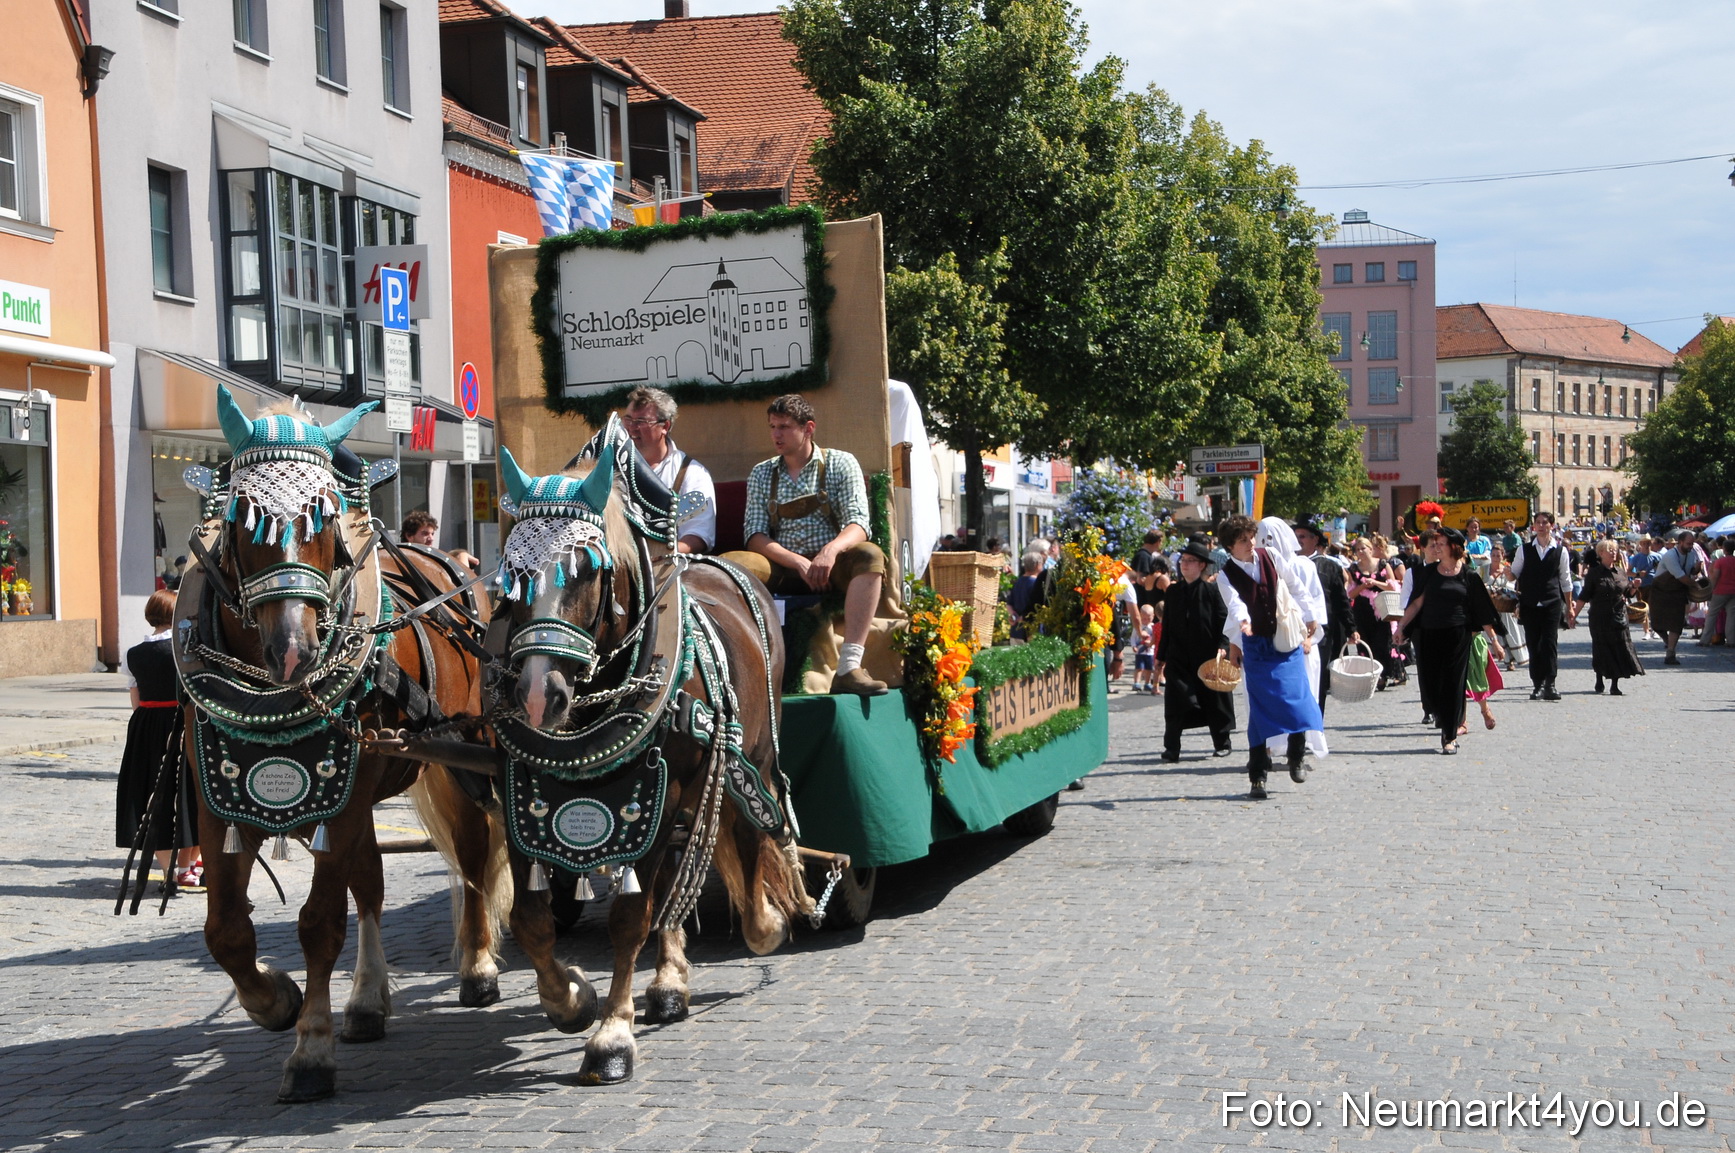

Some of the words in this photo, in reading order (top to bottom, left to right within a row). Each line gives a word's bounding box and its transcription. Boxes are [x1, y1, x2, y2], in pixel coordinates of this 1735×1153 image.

[362, 261, 421, 304] HM
[3, 291, 41, 325] Punkt
[387, 276, 403, 322] P
[563, 304, 706, 334] Schloßspiele
[571, 332, 645, 350] Neumarkt
[1202, 449, 1250, 459] Parkleitsystem
[1219, 463, 1251, 471] Rosengasse
[1472, 504, 1517, 515] Express
